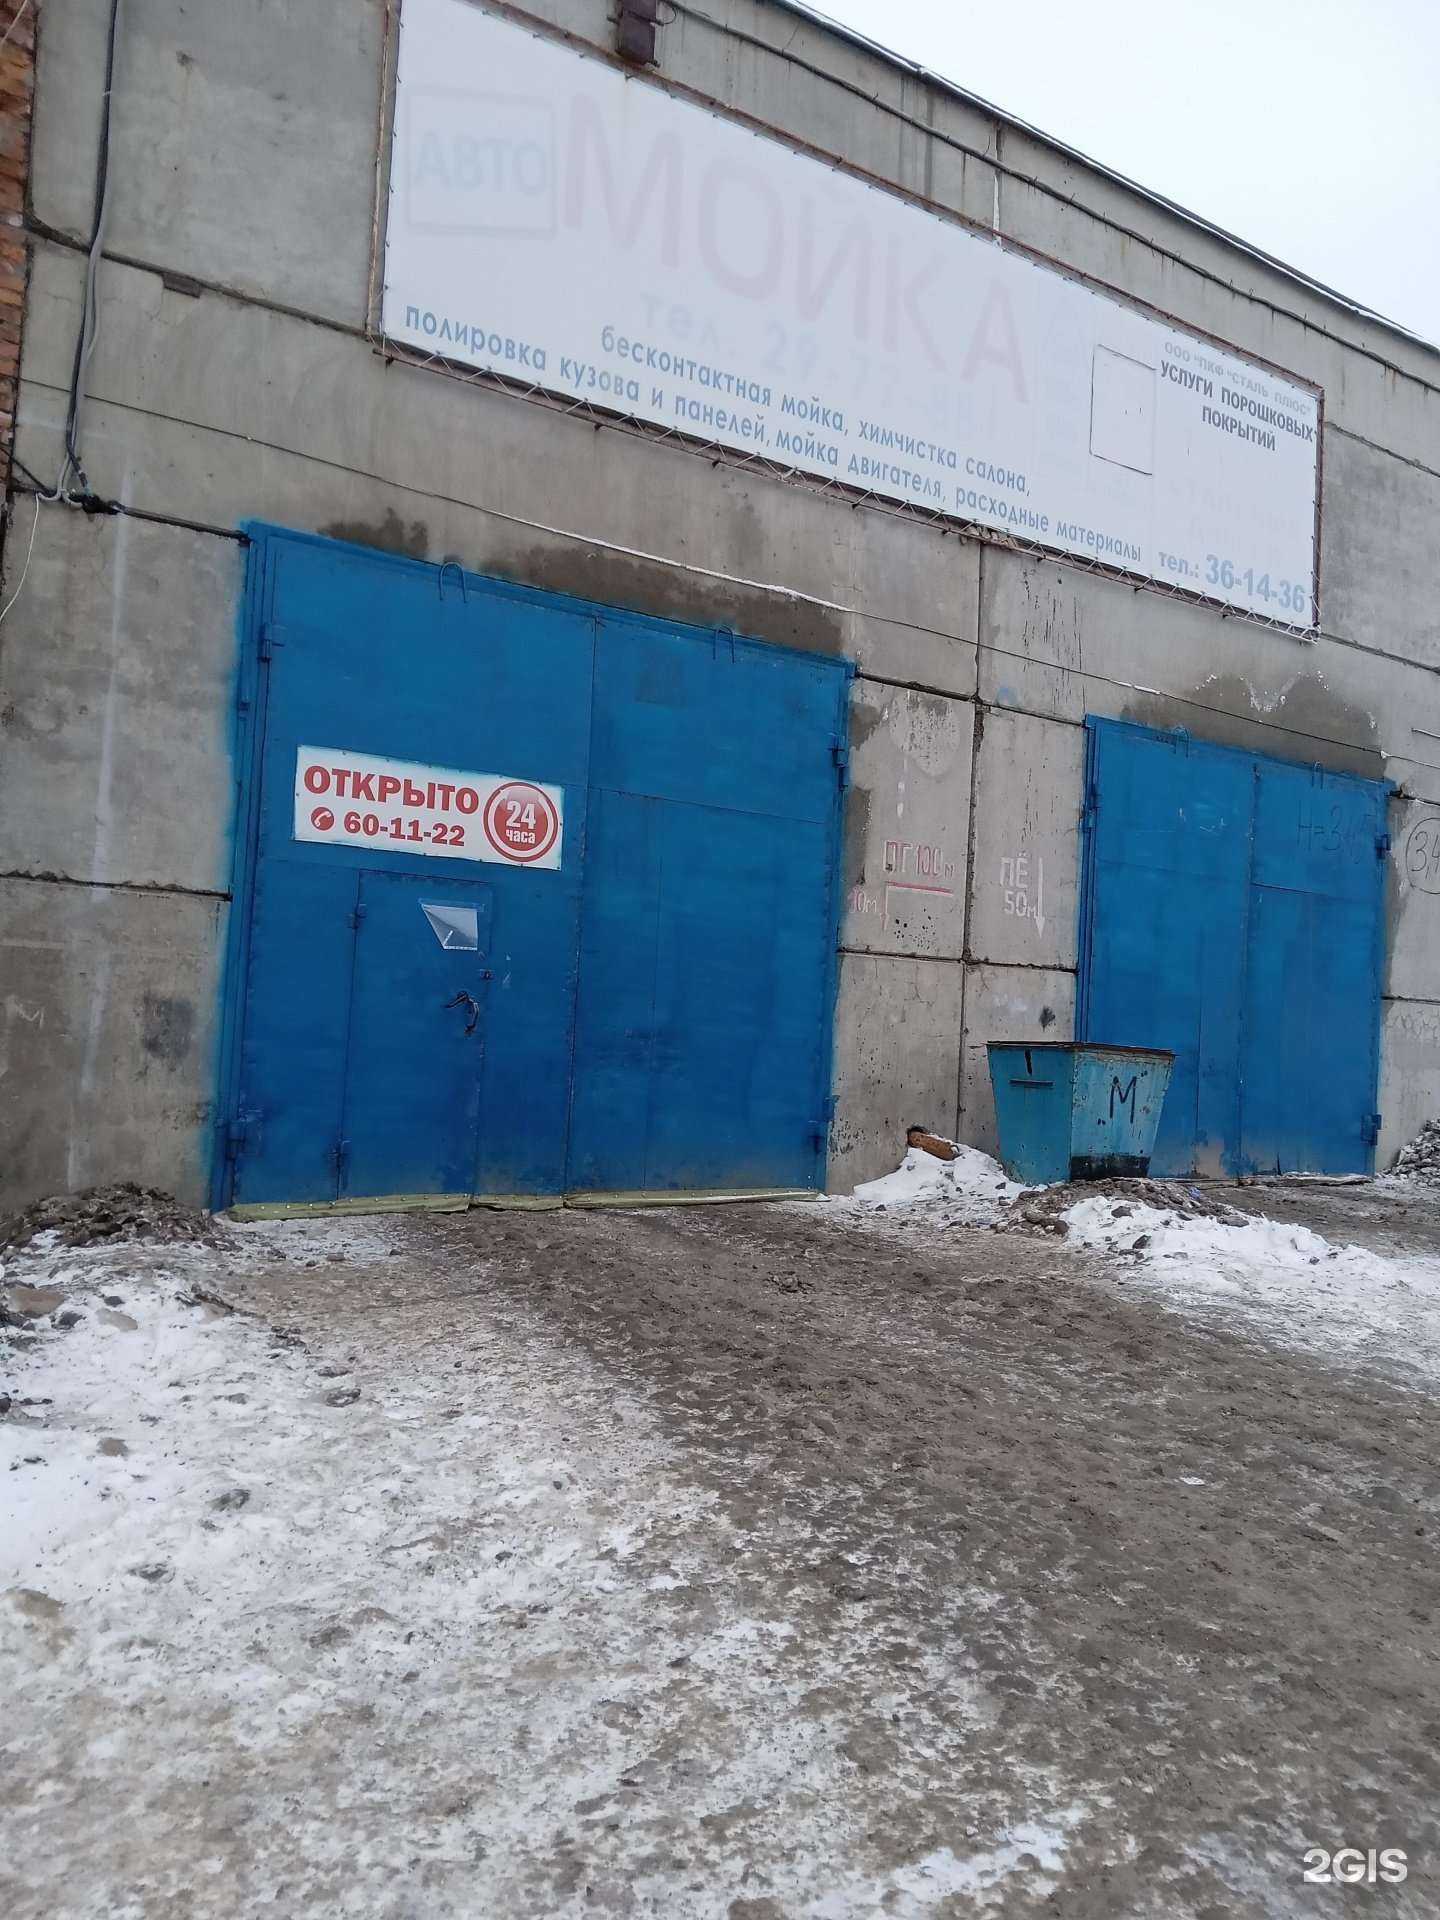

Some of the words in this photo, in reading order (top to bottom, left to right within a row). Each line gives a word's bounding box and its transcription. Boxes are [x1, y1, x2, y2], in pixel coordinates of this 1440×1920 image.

[1164, 341, 1191, 363] ООО
[601, 325, 771, 406] бесконтактная
[781, 394, 849, 435] мойка,
[859, 420, 957, 469] химчистка
[965, 456, 1031, 497] салона,
[1160, 359, 1213, 399] УСЛУГИ
[1221, 387, 1314, 443] ПОРОШКОВЫХ
[405, 305, 546, 370] полировка
[560, 356, 640, 402] кузова
[651, 387, 663, 409] и
[675, 394, 770, 447] панелей,
[776, 429, 839, 466] мойка
[848, 453, 946, 503] двигателя,
[955, 486, 1049, 532] расходные
[1056, 519, 1141, 562] материалы
[1202, 405, 1277, 452] ПОКРЫТИЙ
[1205, 553, 1306, 613] 36-14-36
[304, 765, 479, 815] ОТКРЫТО
[344, 811, 465, 847] 60-11-22
[505, 801, 537, 830] 24
[505, 829, 536, 845] часа
